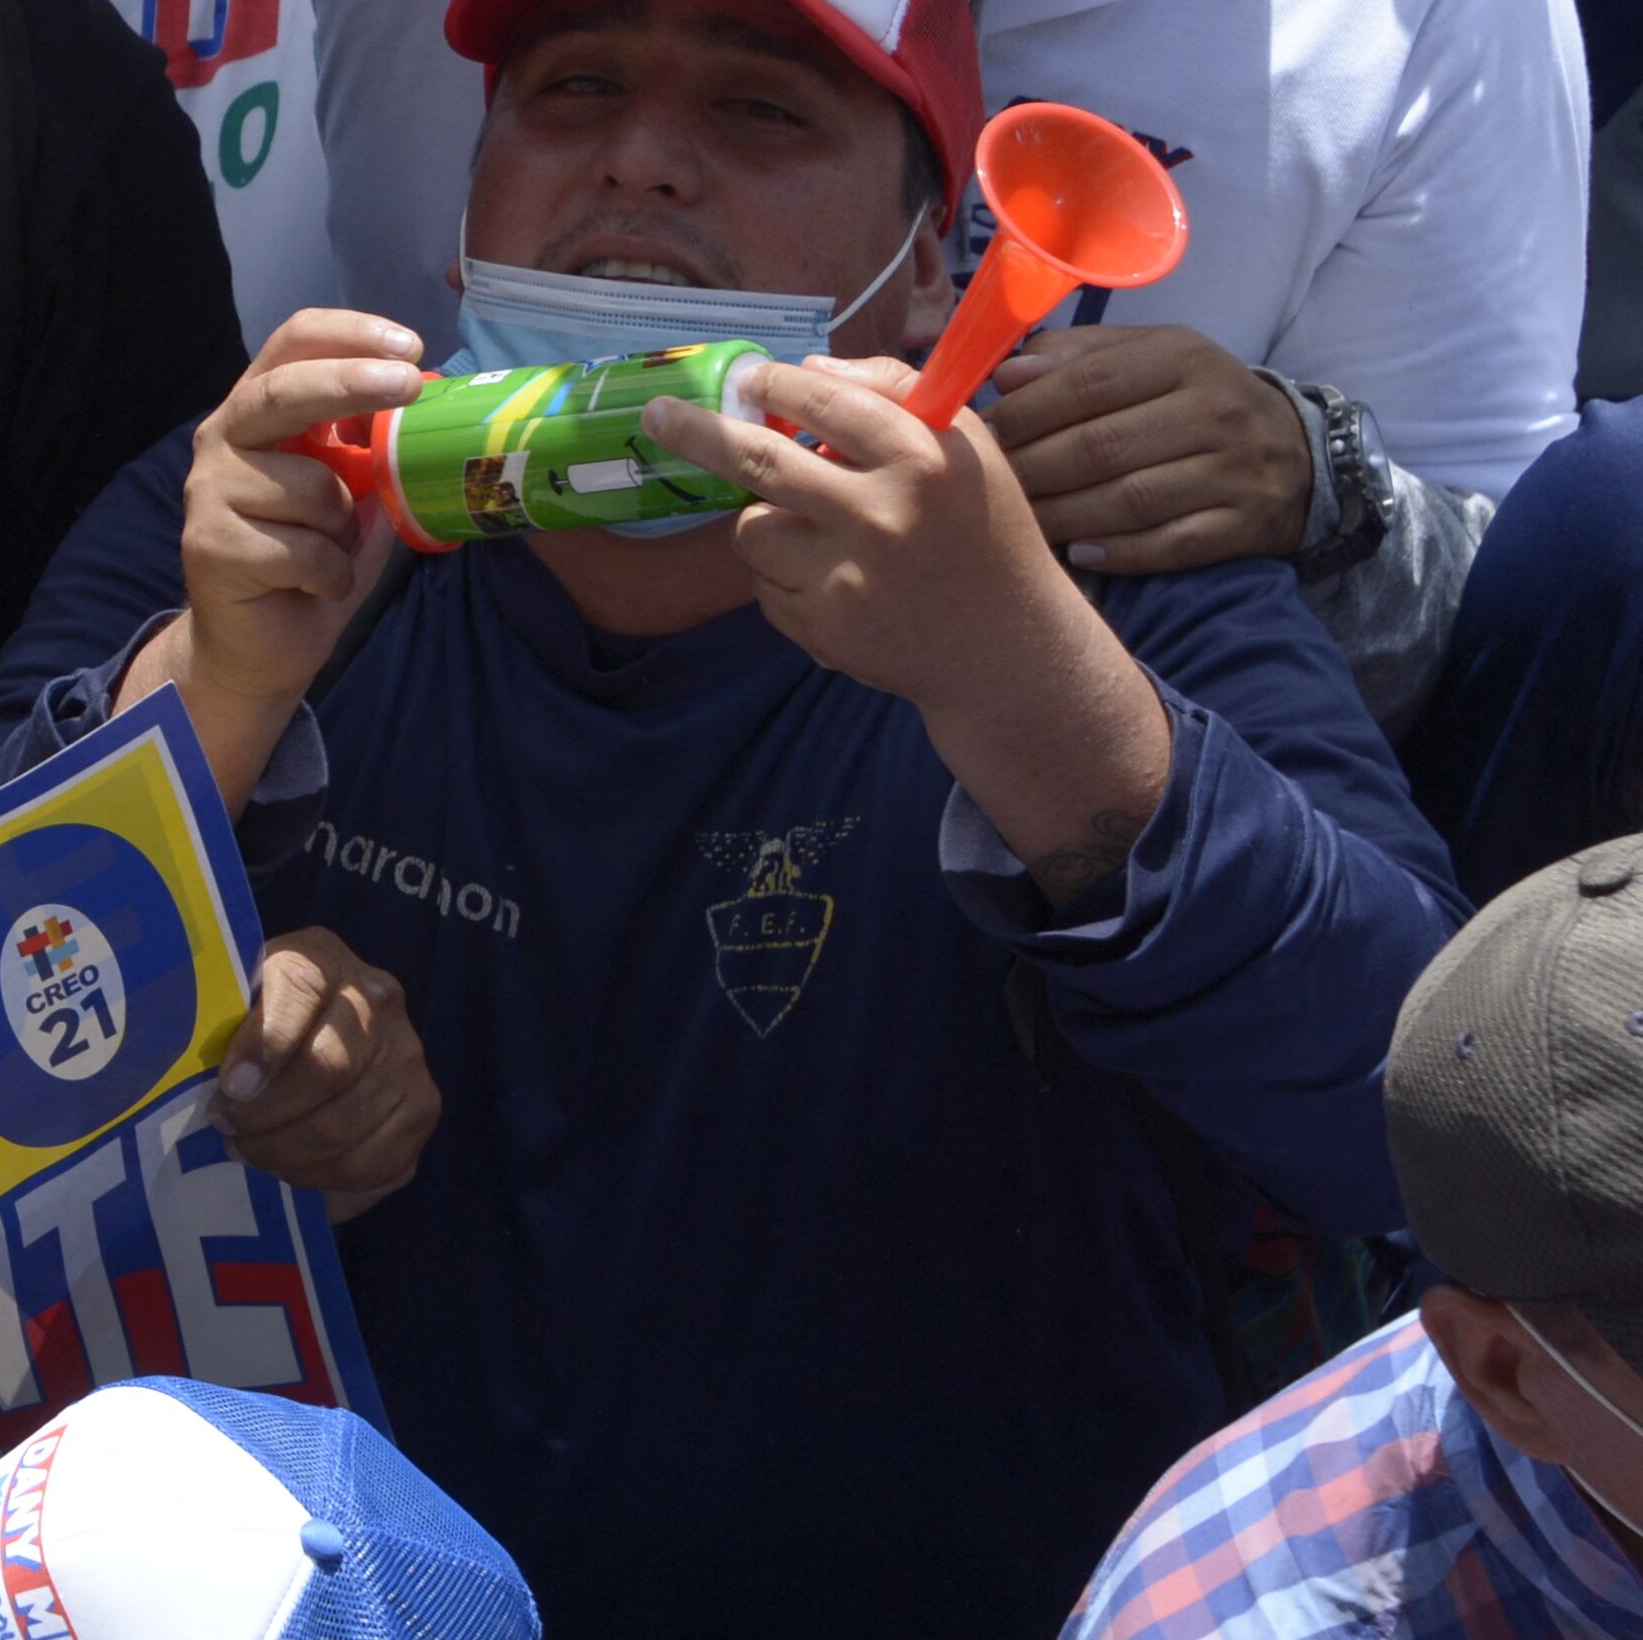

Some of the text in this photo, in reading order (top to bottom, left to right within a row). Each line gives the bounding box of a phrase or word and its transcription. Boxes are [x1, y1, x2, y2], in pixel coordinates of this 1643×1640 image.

[25, 964, 100, 1015] CREO
[38, 986, 118, 1069] 21
[2, 1436, 62, 1573] DANY
